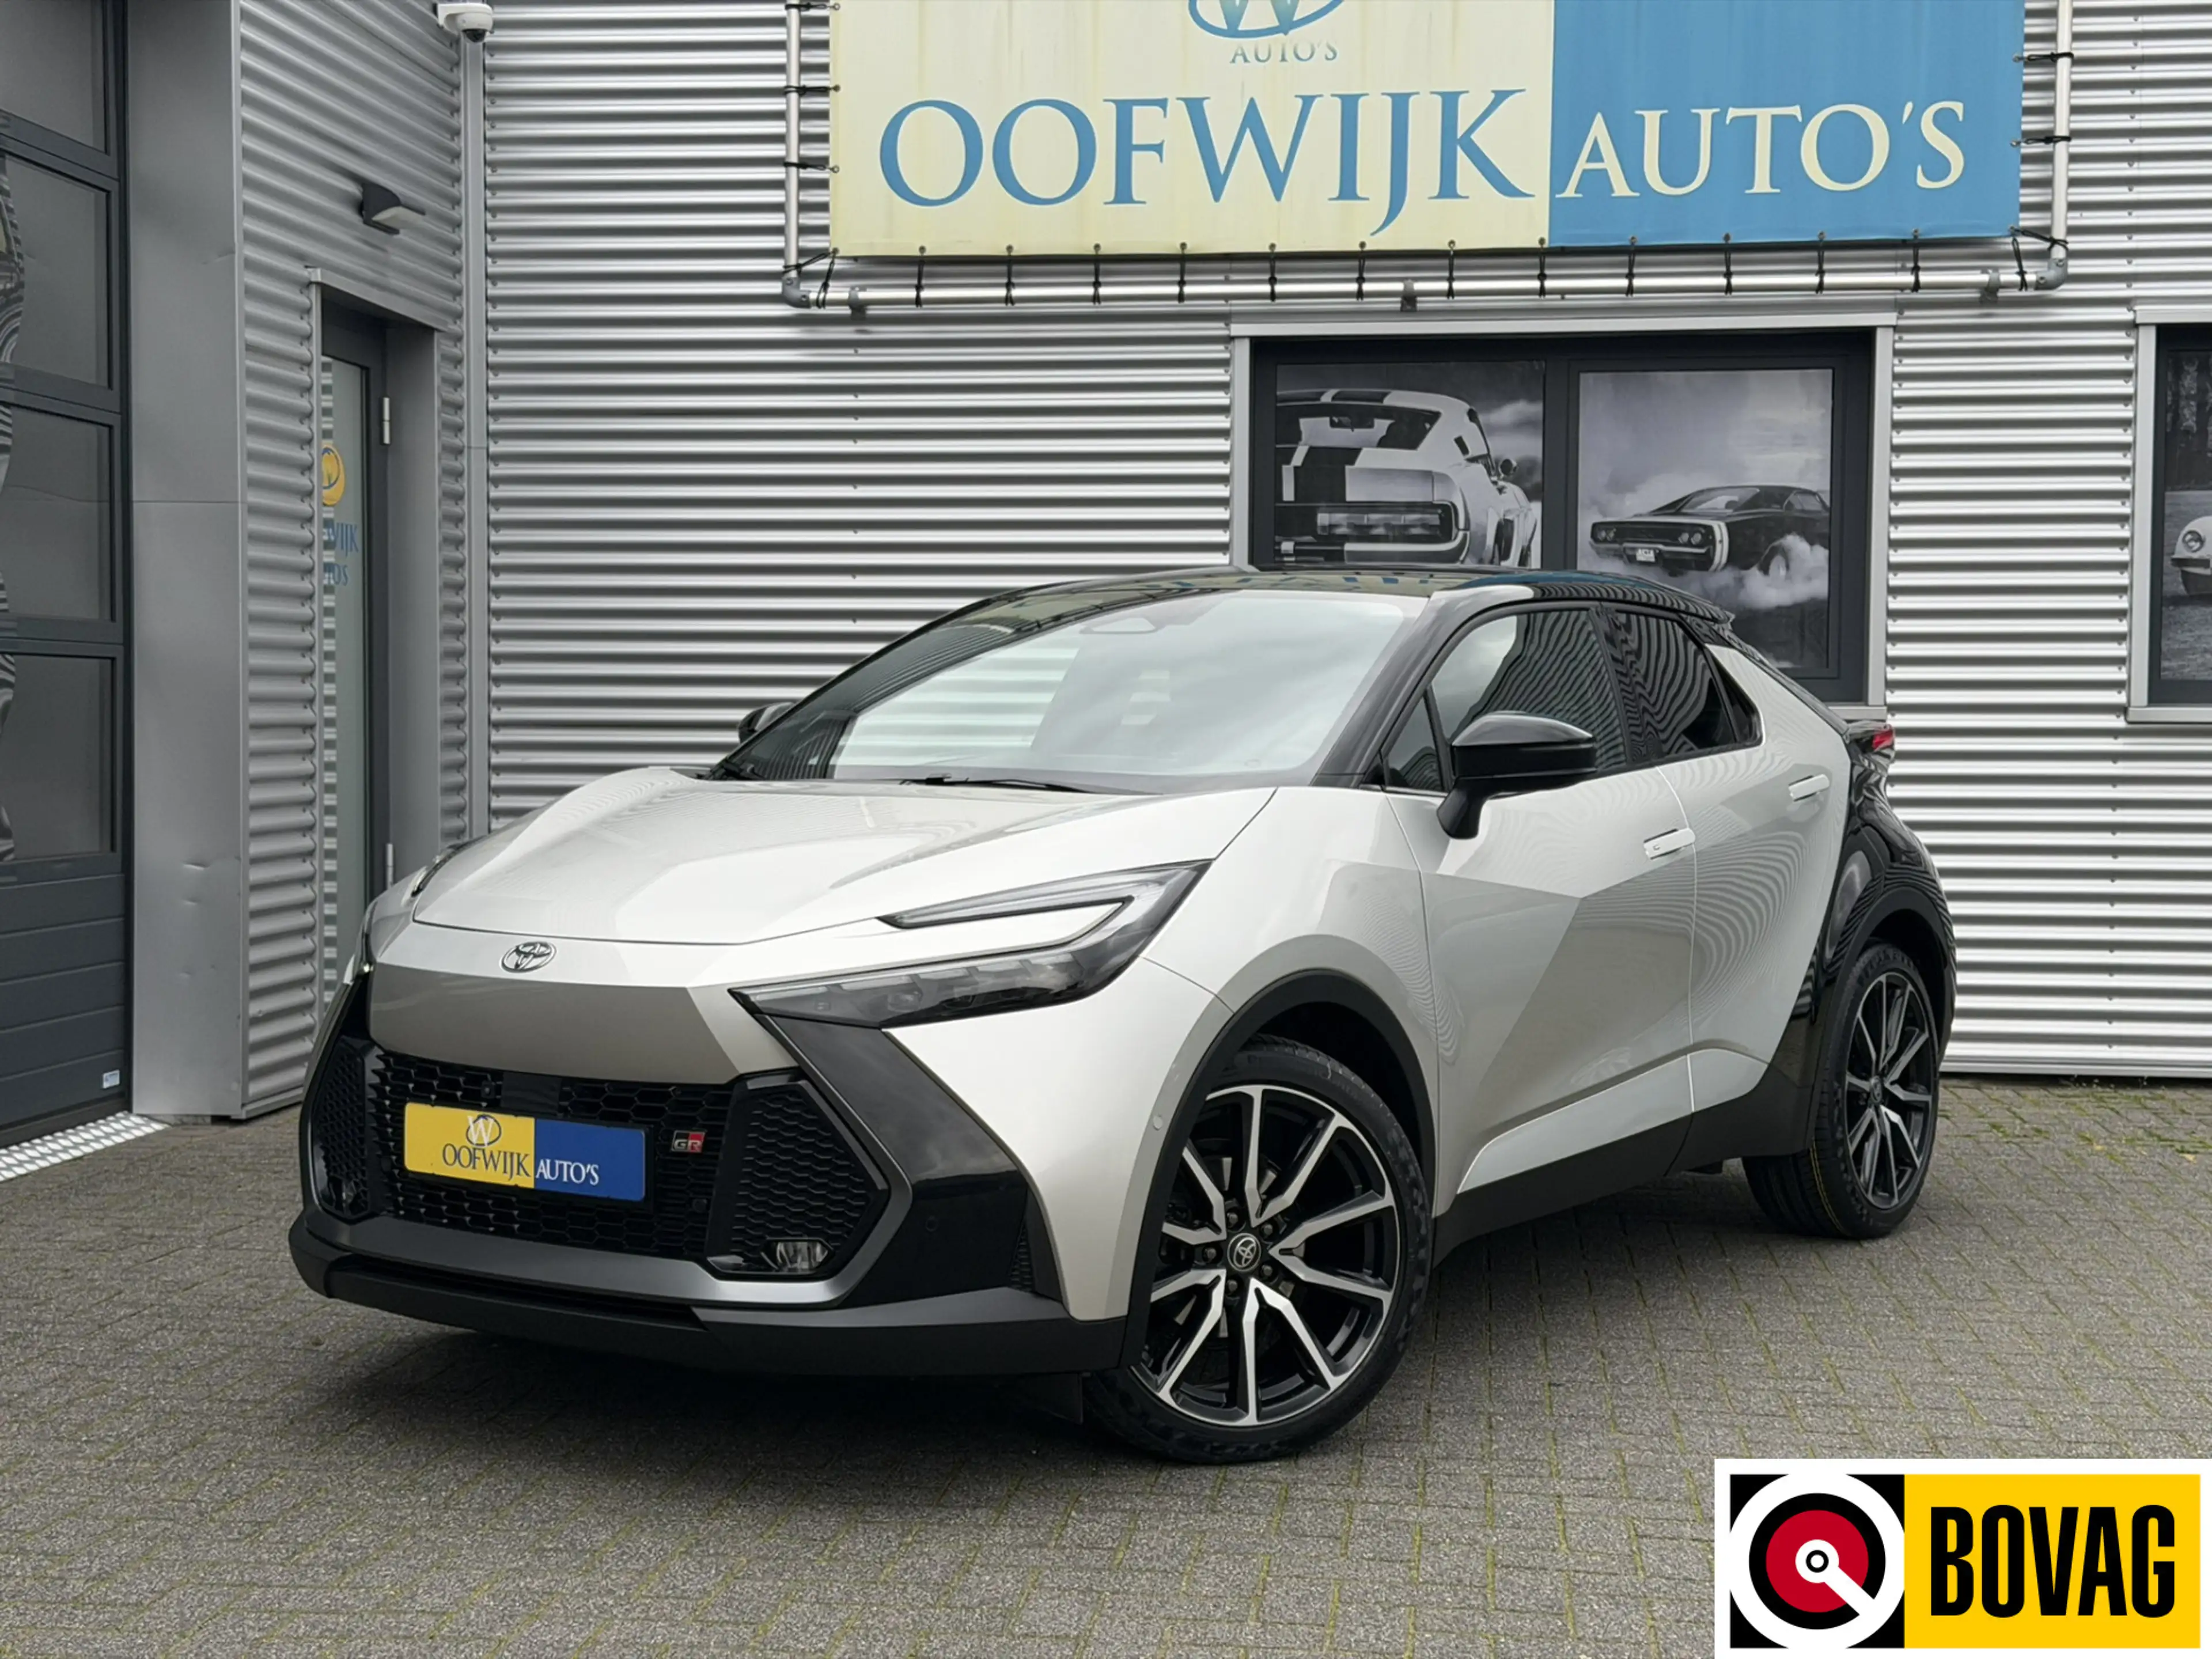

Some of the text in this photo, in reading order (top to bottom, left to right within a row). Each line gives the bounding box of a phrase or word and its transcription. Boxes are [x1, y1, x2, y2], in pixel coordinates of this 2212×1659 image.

[1229, 39, 1338, 63] AUTO'S
[879, 89, 1966, 237] OOFWIJK AUTO'S
[674, 1139, 702, 1152] GR
[442, 1143, 600, 1185] OOFWIJK AUTO'S
